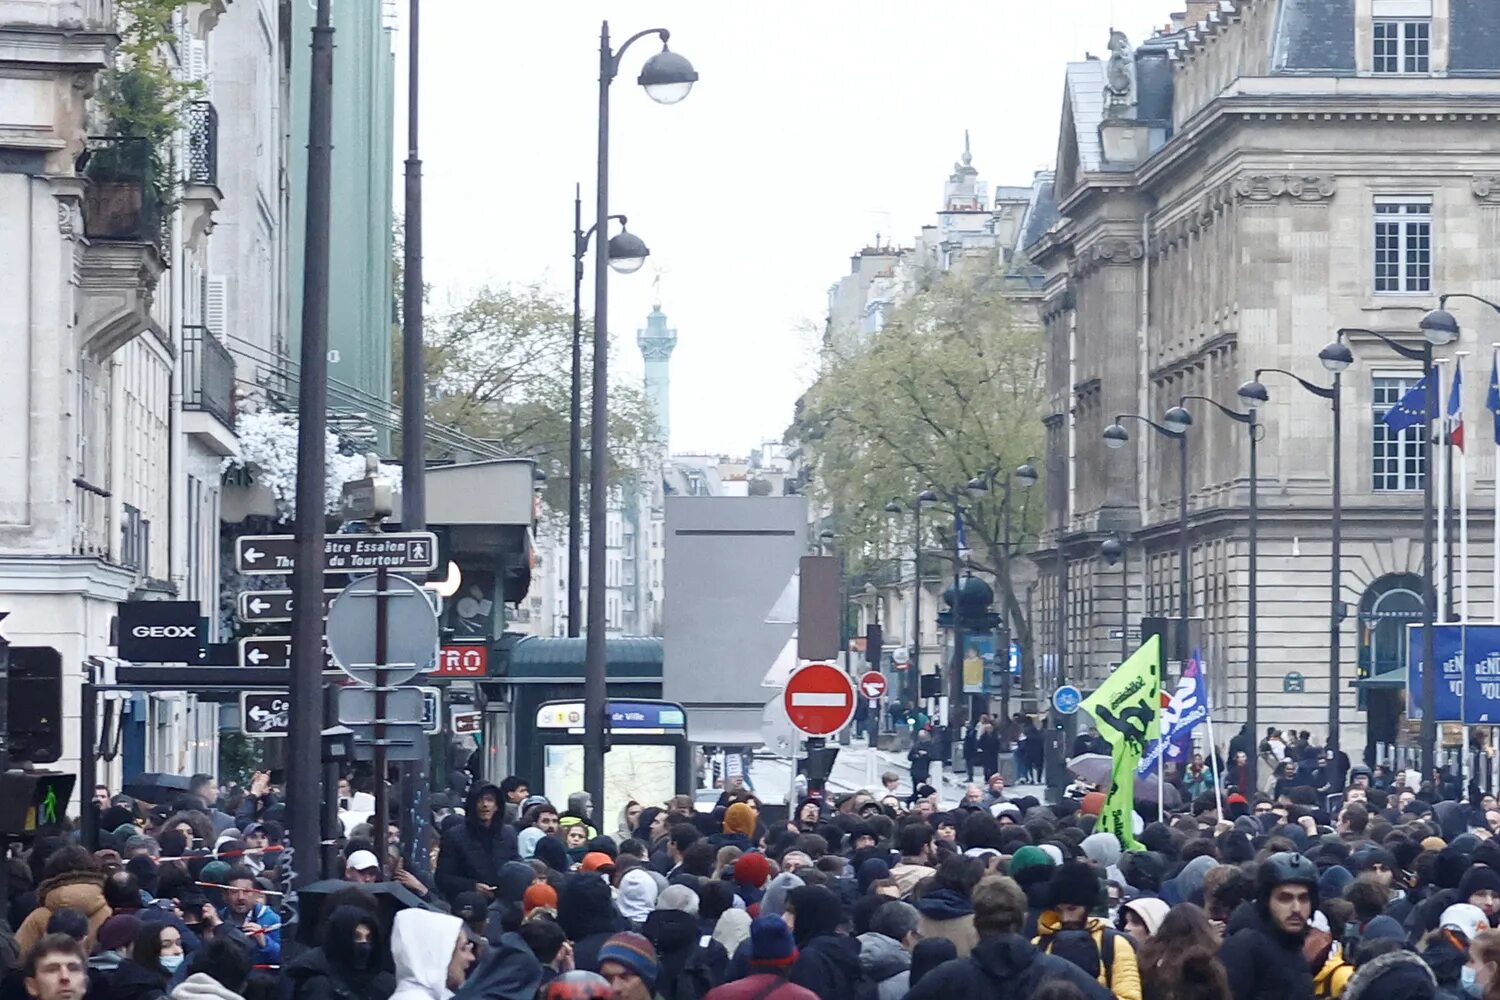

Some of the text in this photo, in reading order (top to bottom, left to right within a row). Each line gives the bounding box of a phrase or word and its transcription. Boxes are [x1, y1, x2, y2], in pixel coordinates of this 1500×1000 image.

[324, 541, 351, 553] âtre
[329, 554, 406, 567] du Tourtour
[132, 625, 197, 638] GEOX
[438, 650, 481, 672] TRO
